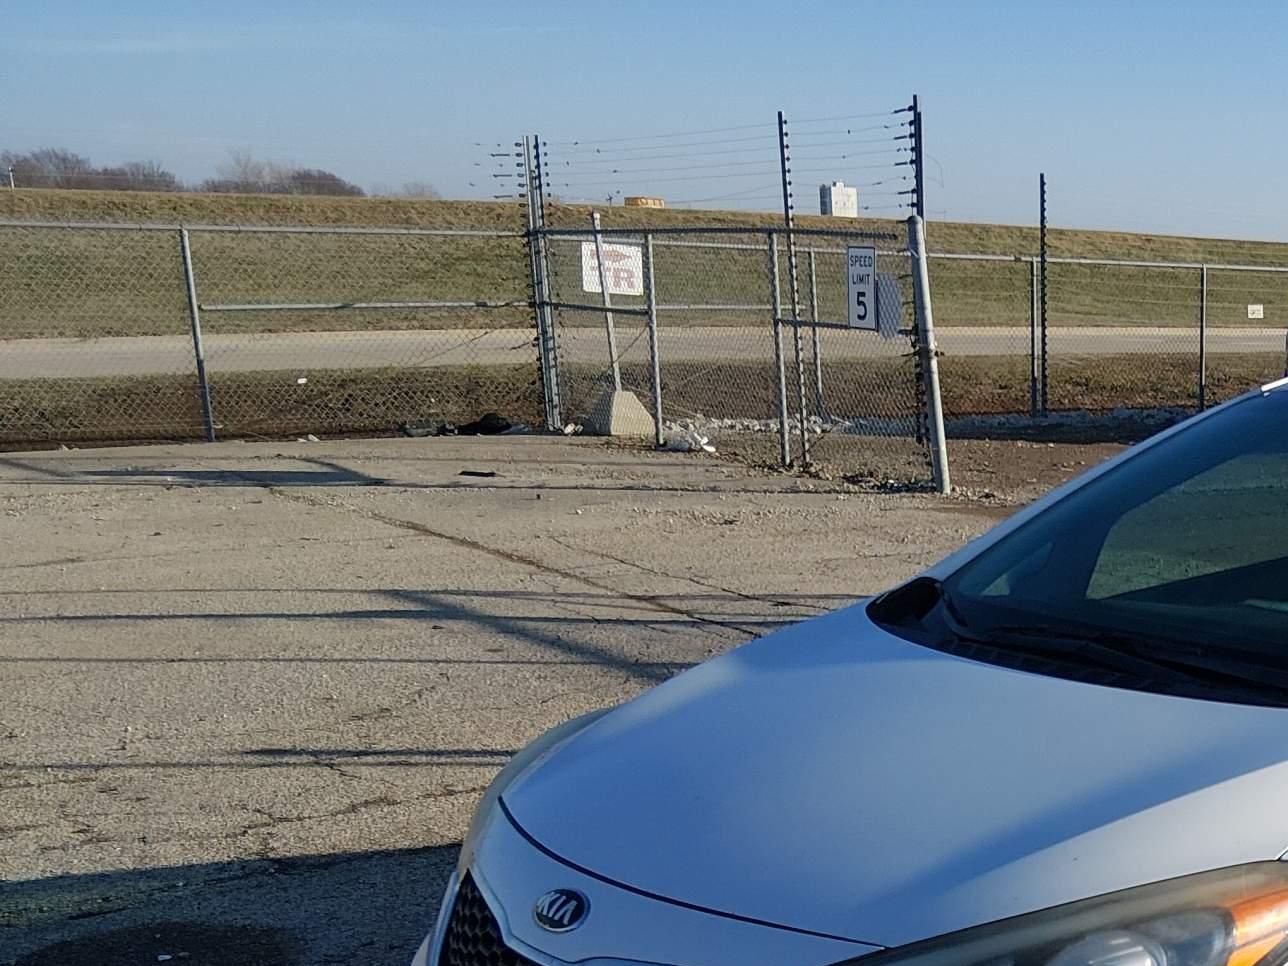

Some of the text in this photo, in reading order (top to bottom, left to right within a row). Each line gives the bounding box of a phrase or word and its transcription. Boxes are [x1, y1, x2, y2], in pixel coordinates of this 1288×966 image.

[849, 255, 873, 268] SPEED
[851, 273, 871, 285] LIMIT
[856, 291, 868, 321] 5
